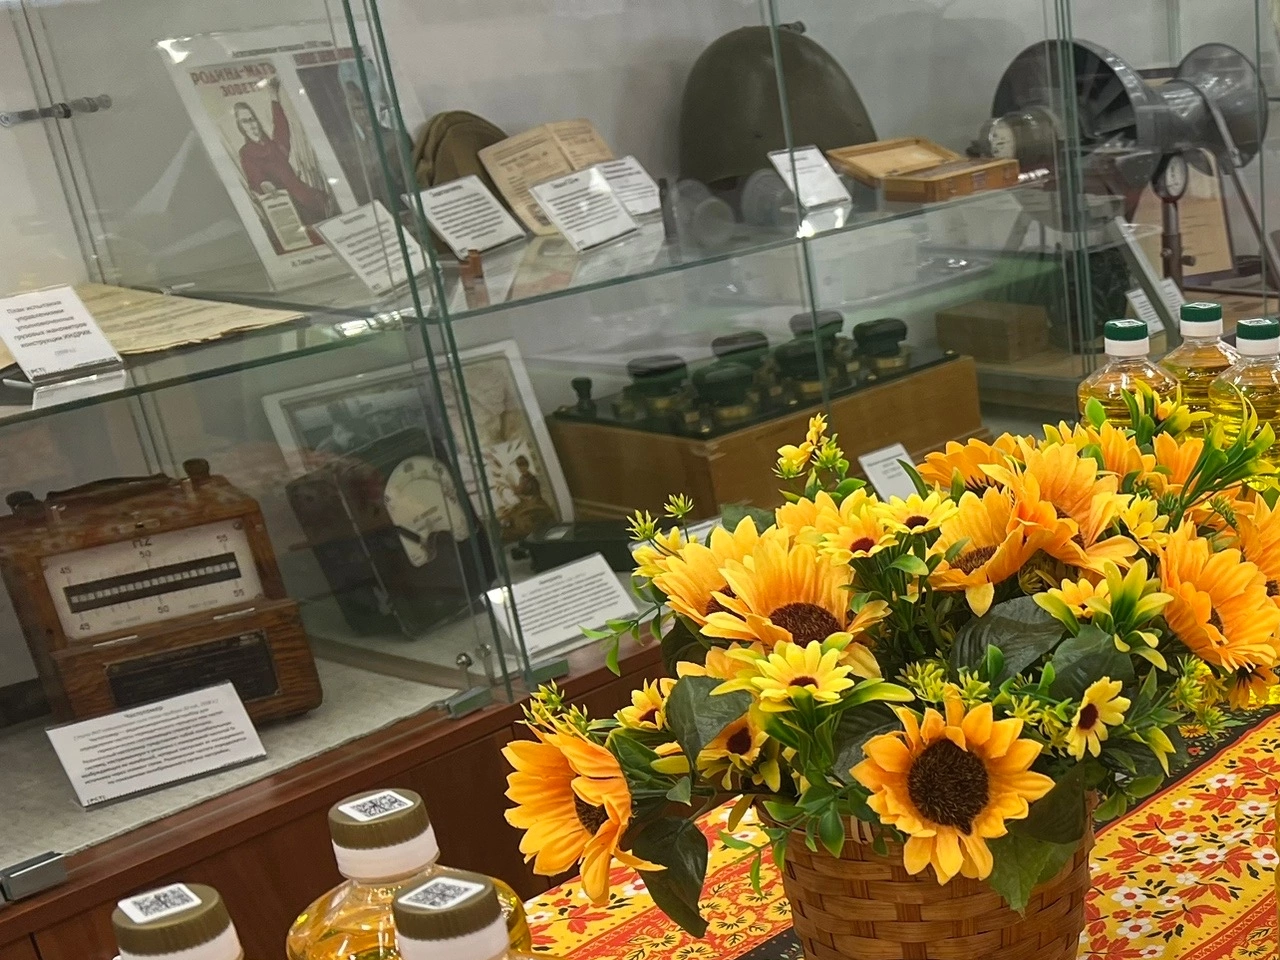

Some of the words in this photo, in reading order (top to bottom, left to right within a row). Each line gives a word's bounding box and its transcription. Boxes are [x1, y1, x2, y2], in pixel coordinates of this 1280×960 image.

[190, 62, 278, 85] РОДИНА-МАТЬ
[60, 566, 72, 576] 45
[139, 550, 152, 559] 50
[79, 622, 91, 632] 45
[157, 605, 170, 614] 50
[233, 588, 245, 598] 55
